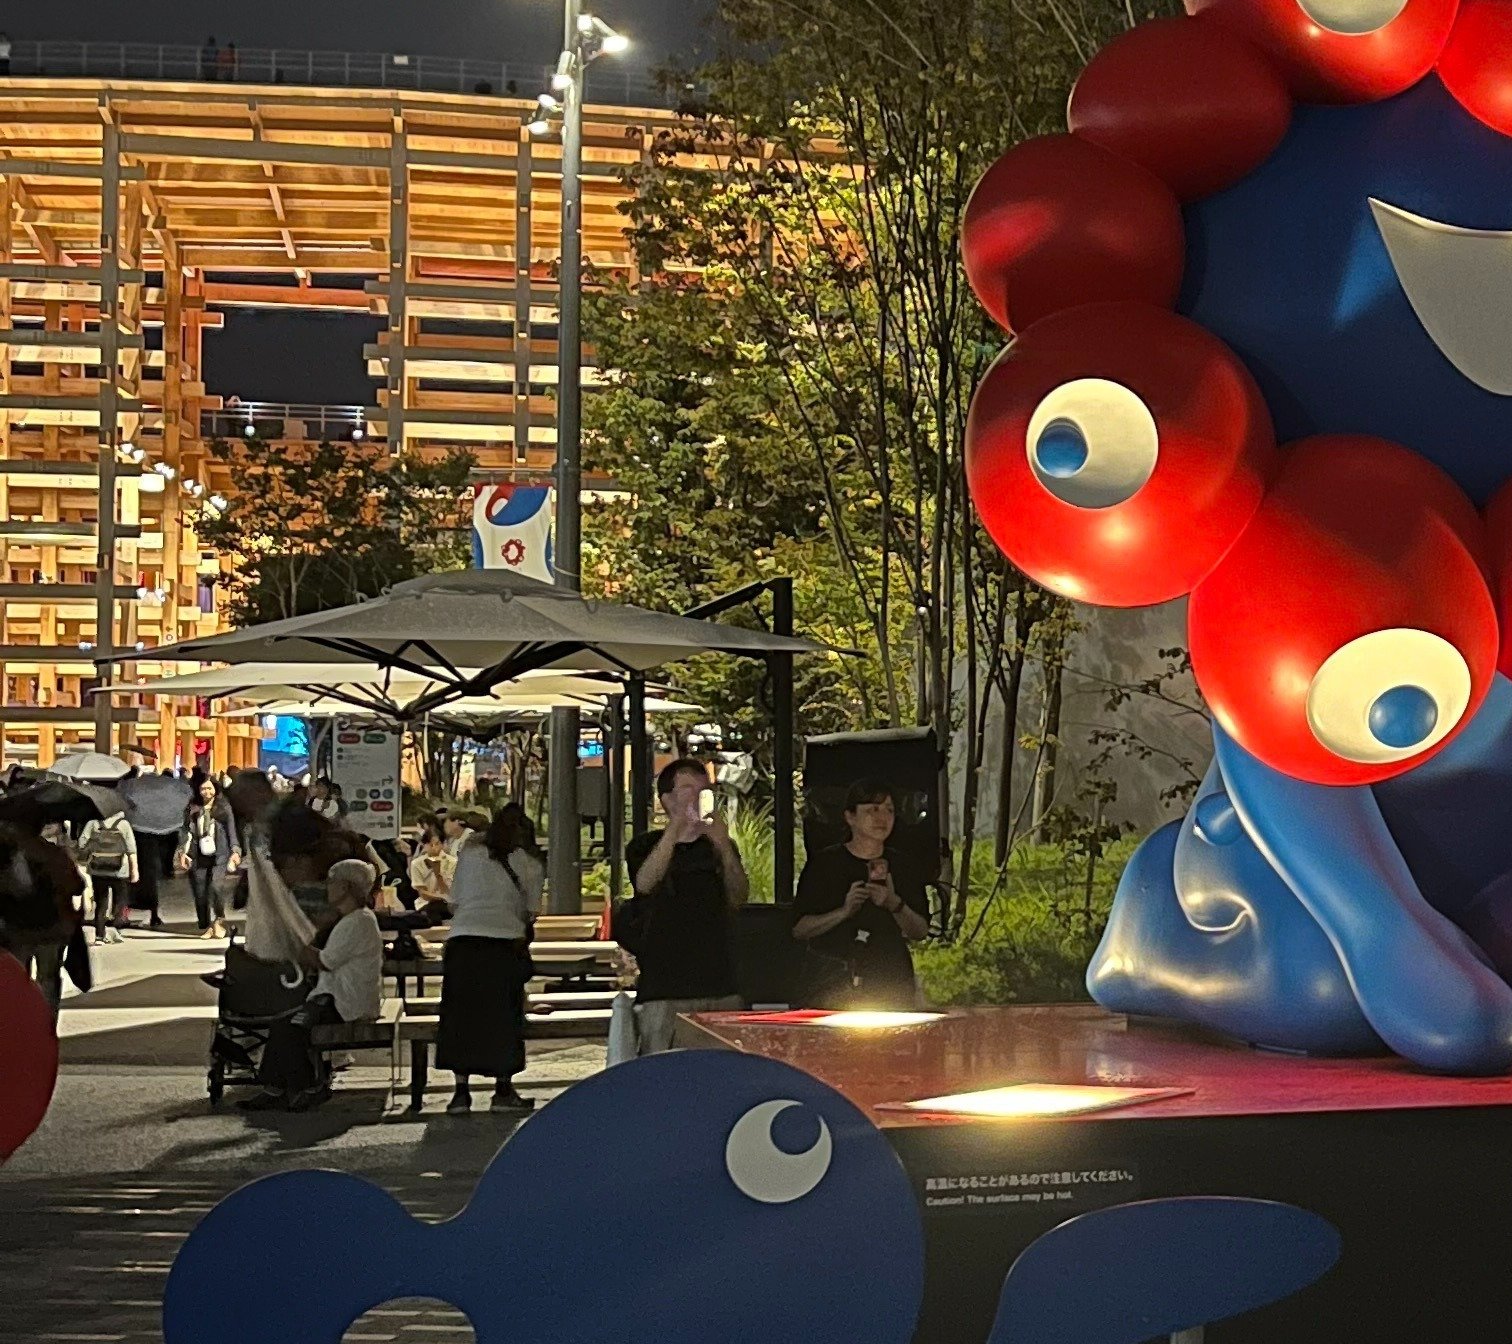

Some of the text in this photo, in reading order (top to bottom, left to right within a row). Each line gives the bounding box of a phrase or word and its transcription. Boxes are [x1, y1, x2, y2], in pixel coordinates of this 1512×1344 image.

[967, 1194, 984, 1204] The
[986, 1193, 1020, 1203] surface
[1021, 1193, 1041, 1203] may
[1043, 1191, 1055, 1200] be
